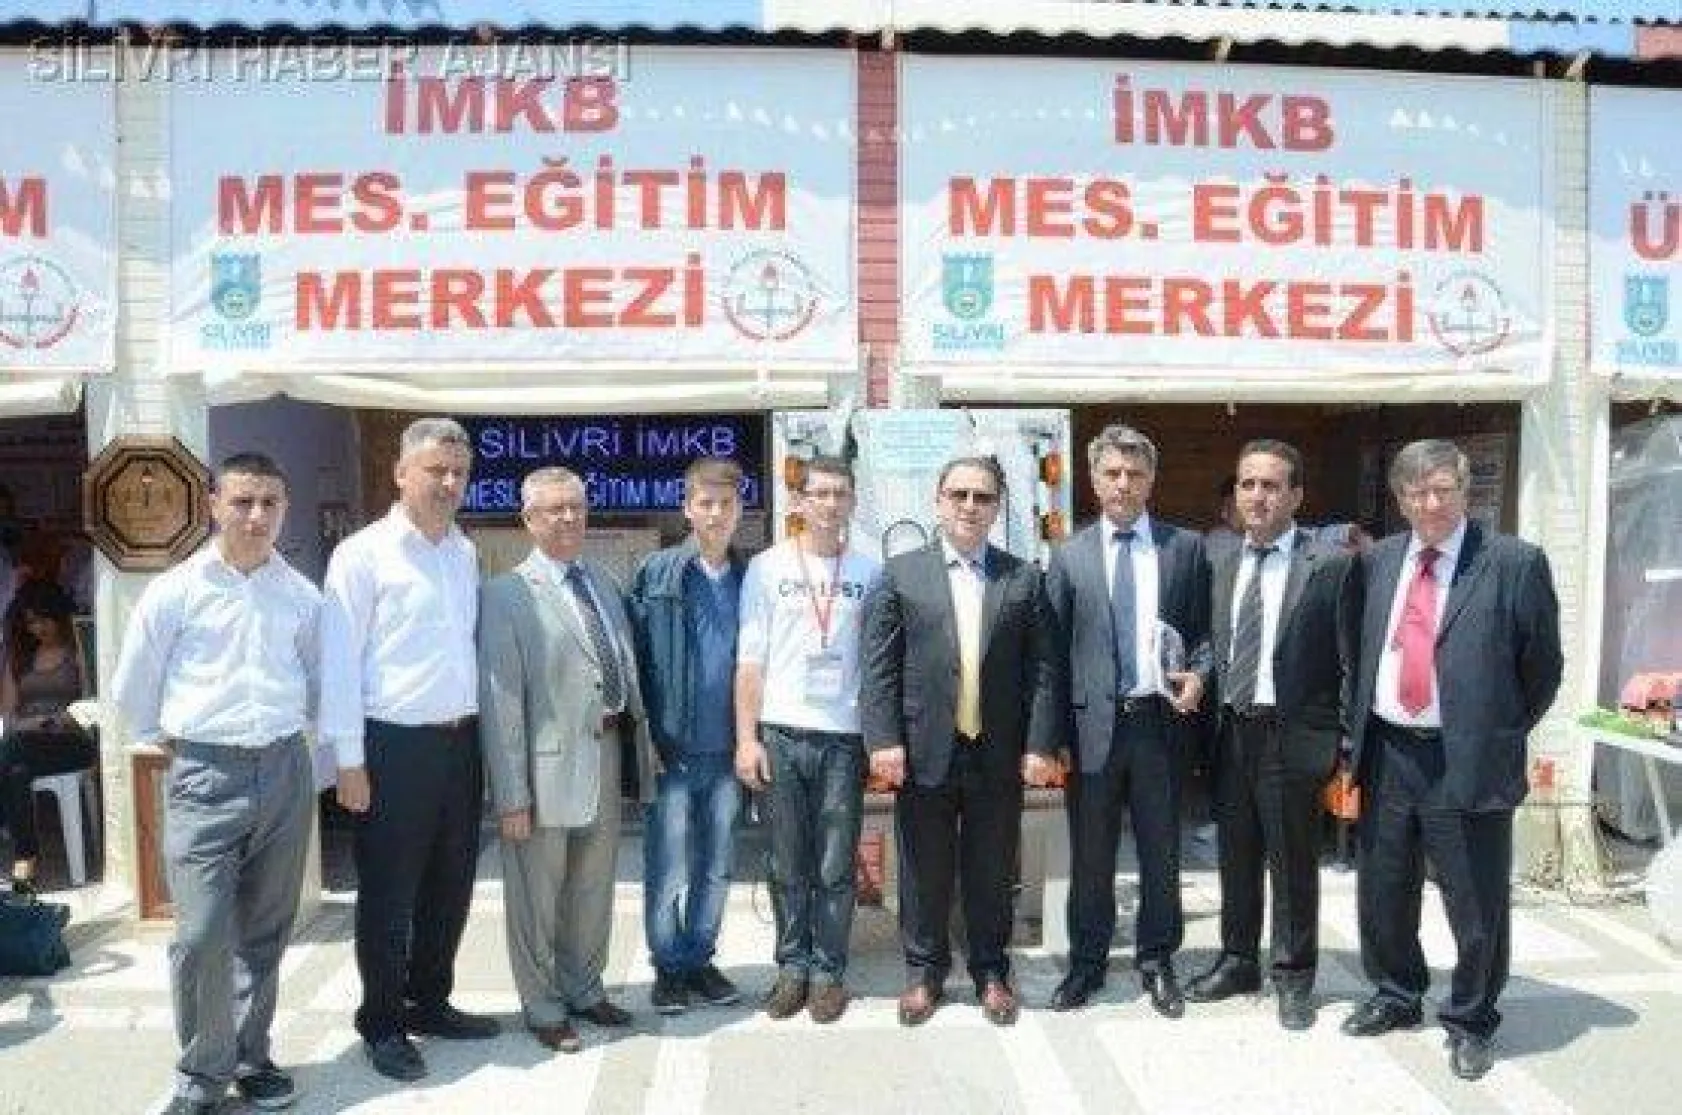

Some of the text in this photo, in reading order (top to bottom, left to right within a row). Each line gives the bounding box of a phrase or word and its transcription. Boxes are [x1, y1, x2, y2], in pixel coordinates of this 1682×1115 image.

[385, 60, 619, 133] İMKB
[1115, 75, 1334, 152] İMKB
[218, 156, 787, 236] MES. EĞİTİM
[948, 173, 1483, 253] MES. EĞİTİM
[295, 254, 705, 332] MERKEZİ
[1028, 271, 1413, 343] MERKEZİ
